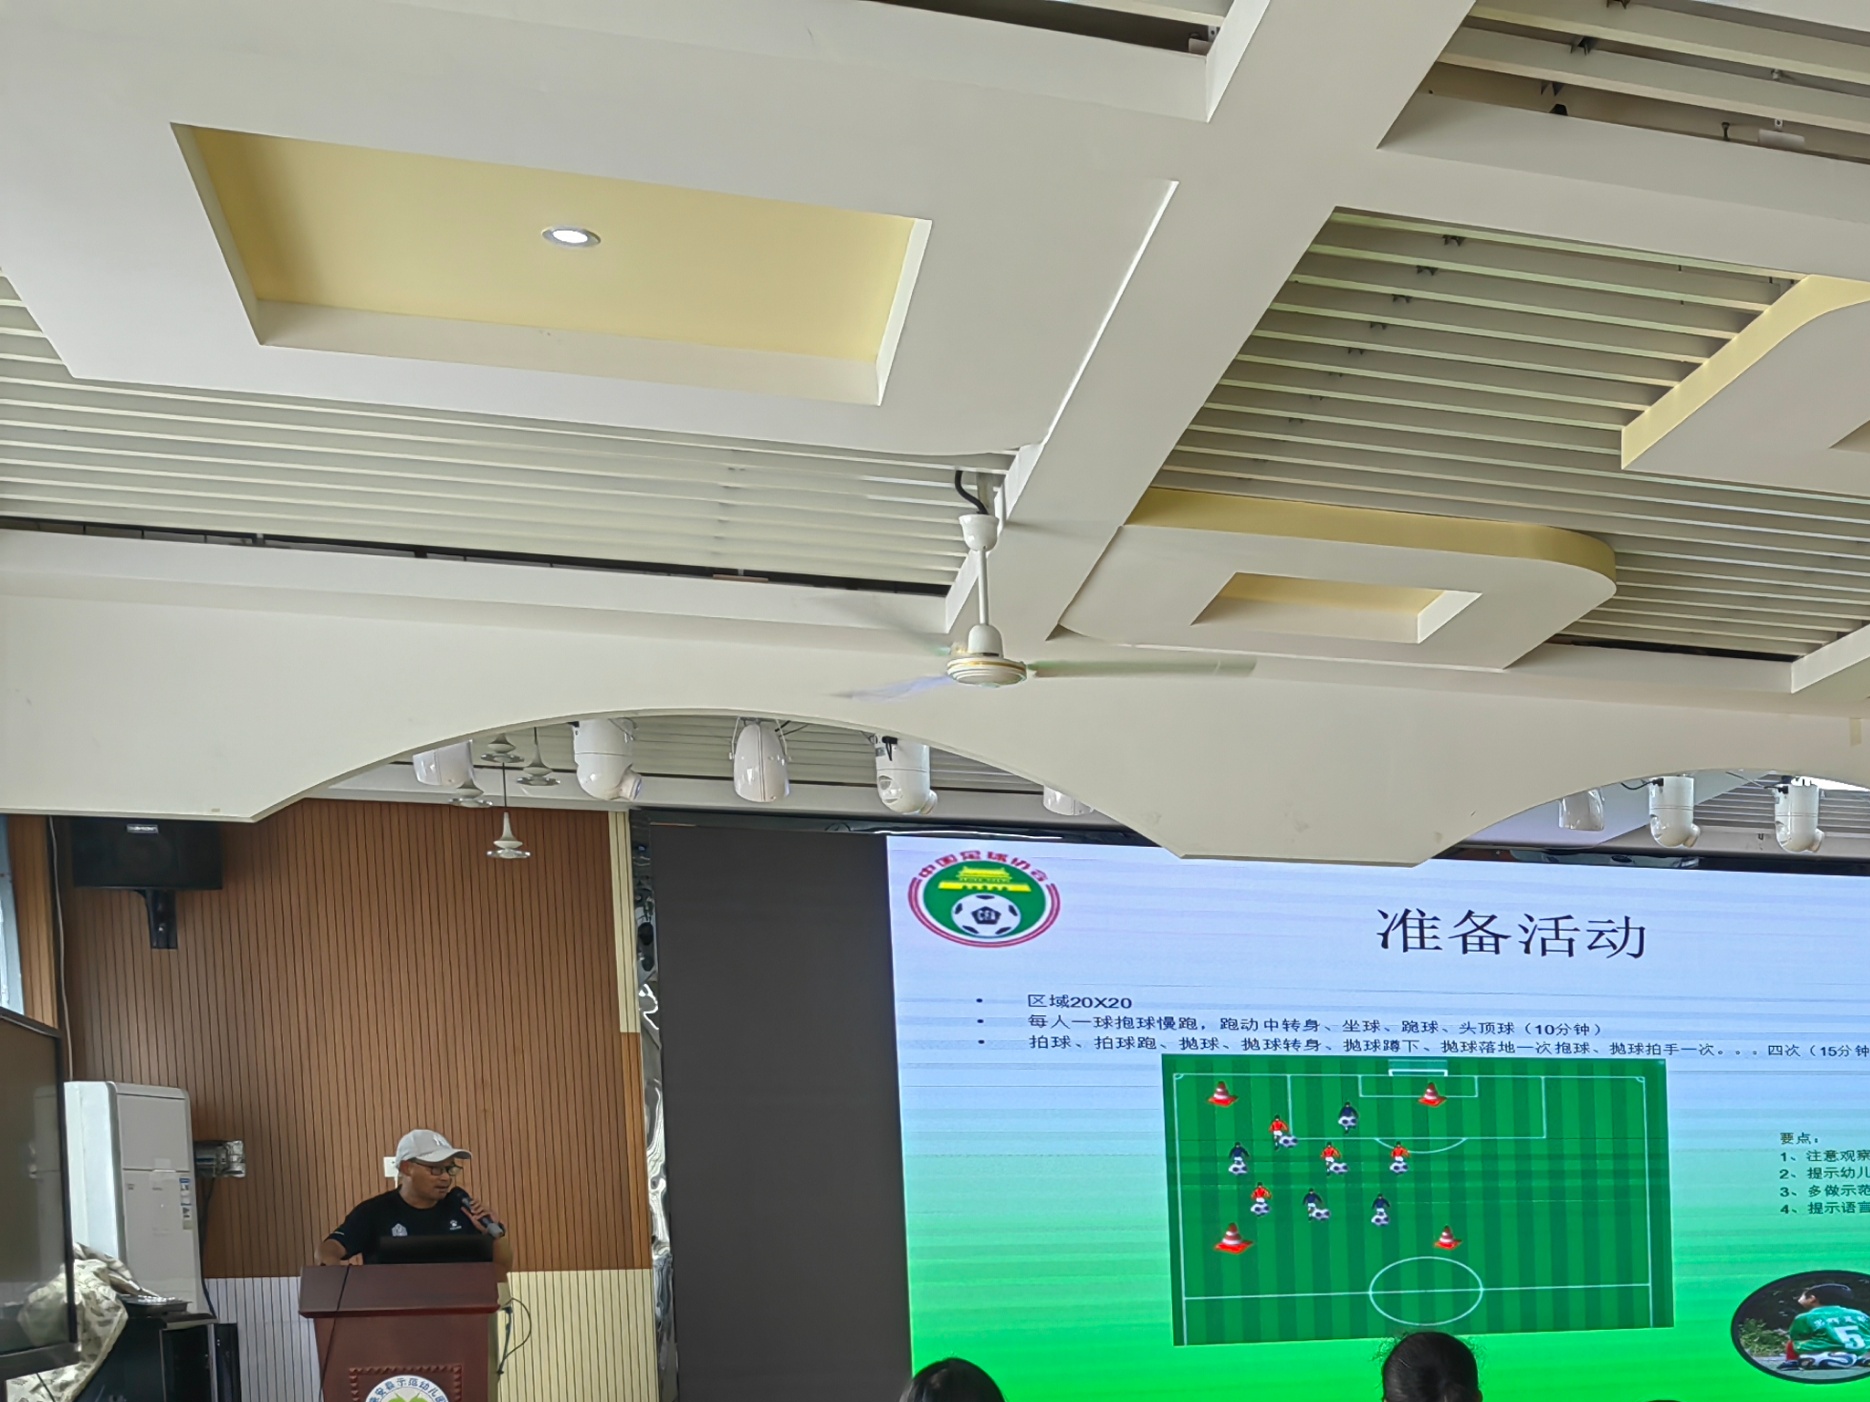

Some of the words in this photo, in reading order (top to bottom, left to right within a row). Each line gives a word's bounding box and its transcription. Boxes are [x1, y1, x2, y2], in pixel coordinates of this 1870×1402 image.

[977, 910, 996, 921] CFA
[1377, 907, 1647, 959] 准备活动
[1834, 1325, 1866, 1349] 5
